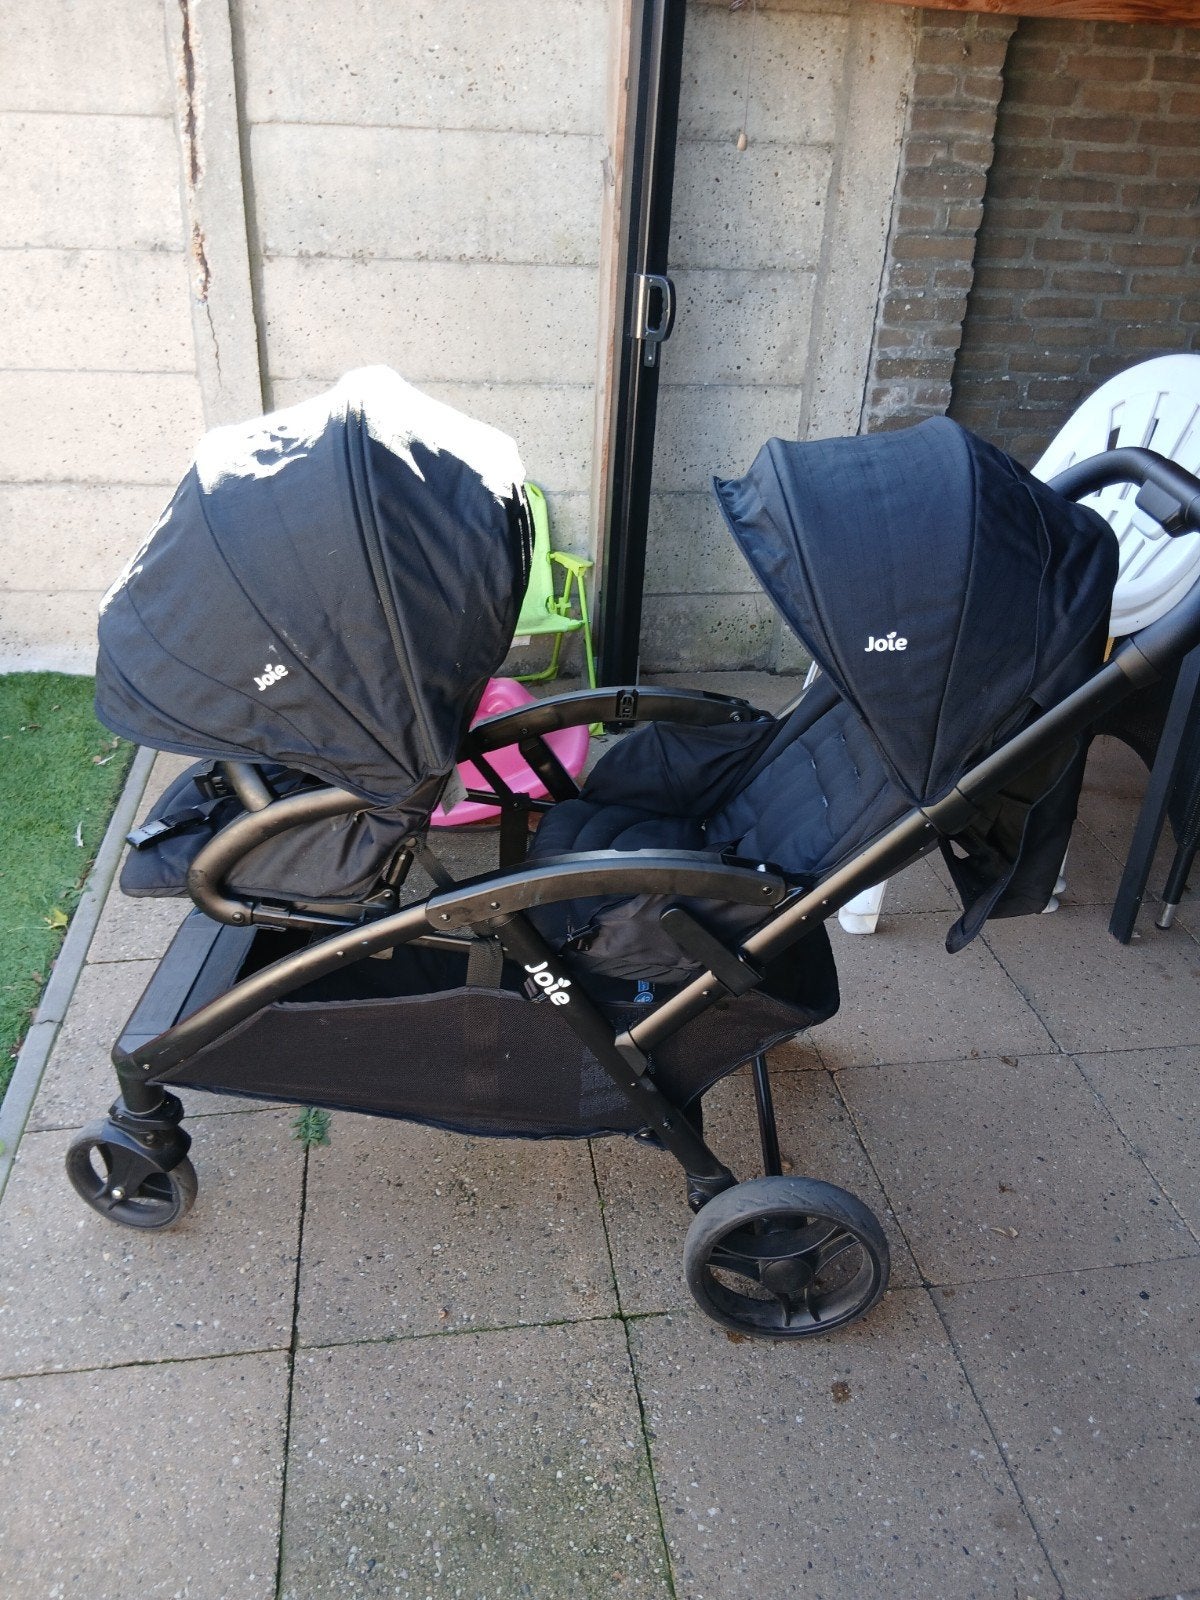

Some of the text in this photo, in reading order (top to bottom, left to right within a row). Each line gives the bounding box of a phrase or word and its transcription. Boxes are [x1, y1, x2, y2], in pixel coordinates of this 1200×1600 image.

[864, 631, 908, 652] Joie
[253, 663, 289, 691] Joie
[524, 961, 572, 1006] Joie
